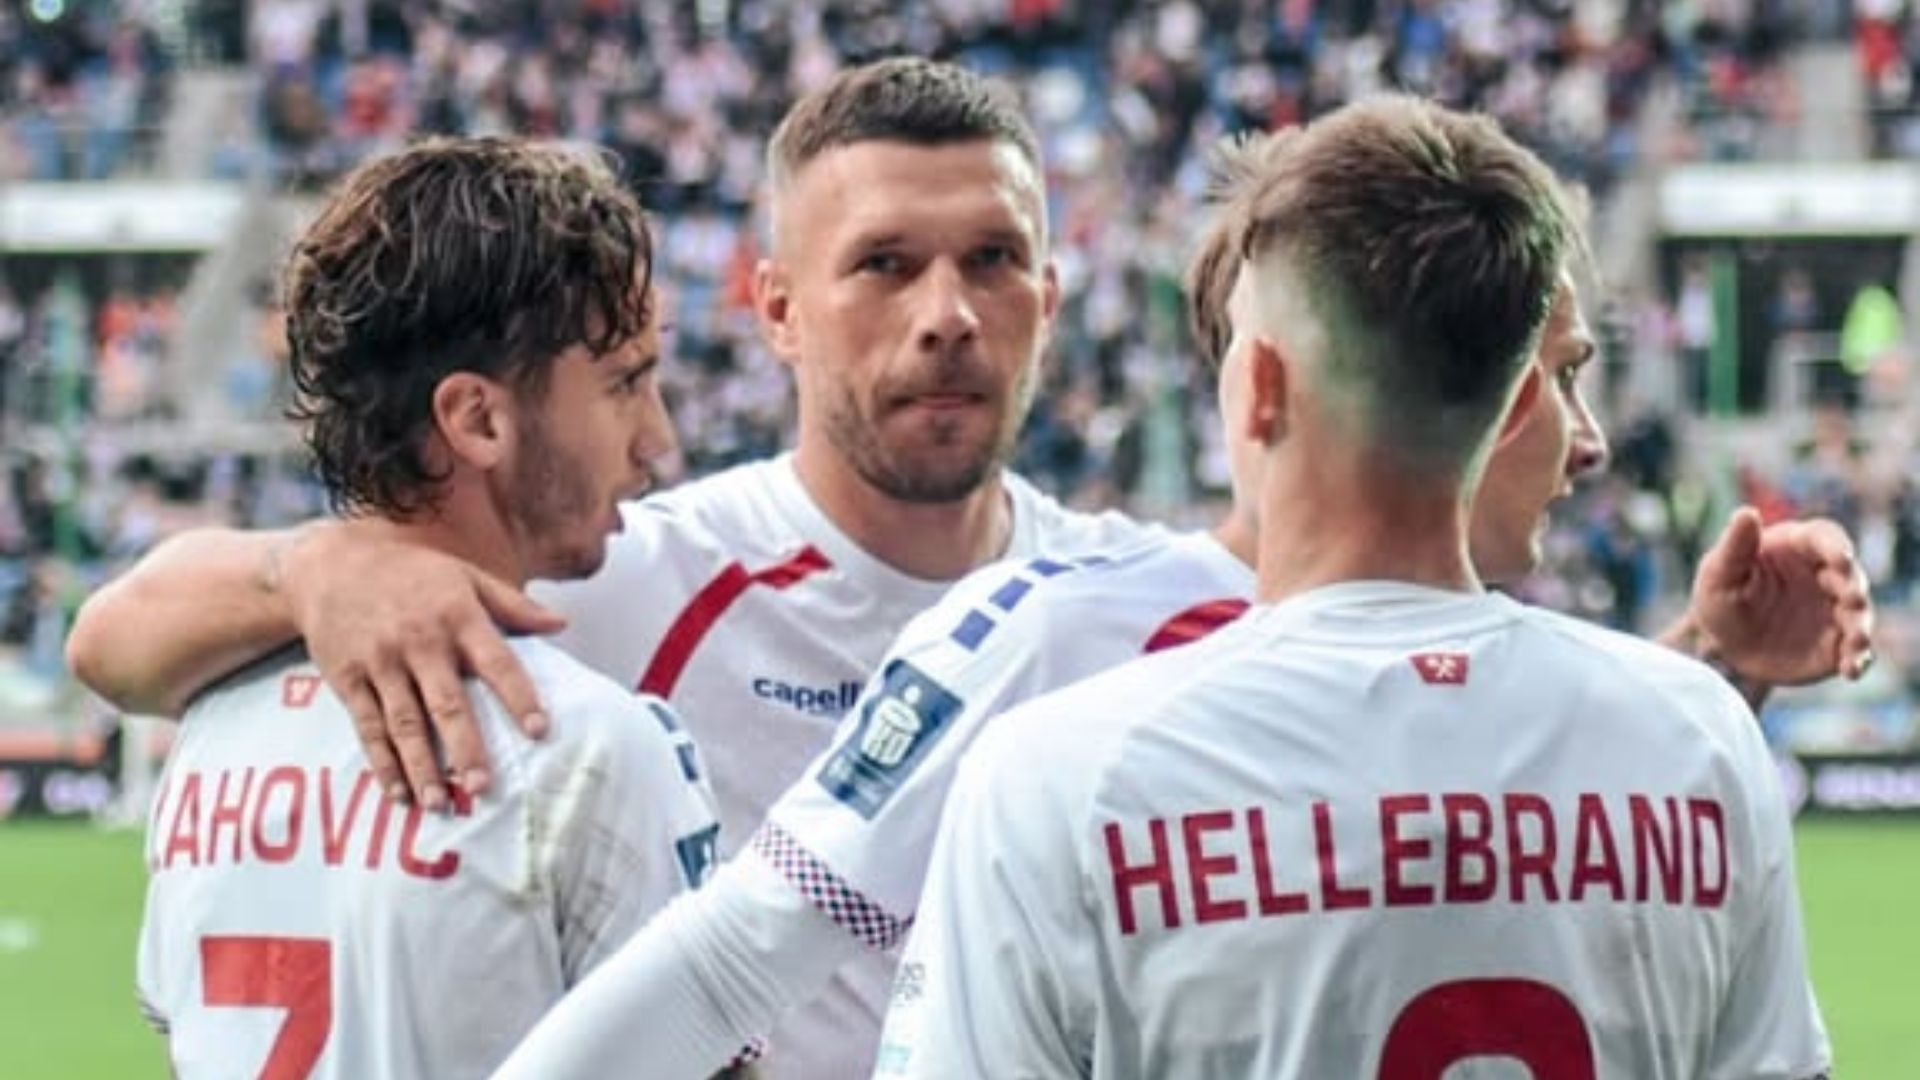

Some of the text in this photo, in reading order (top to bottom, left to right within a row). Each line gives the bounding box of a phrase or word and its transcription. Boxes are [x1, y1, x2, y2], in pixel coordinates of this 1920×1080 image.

[753, 679, 863, 711] capell
[1104, 793, 1729, 935] HELLEBRAND
[200, 936, 332, 1080] 7
